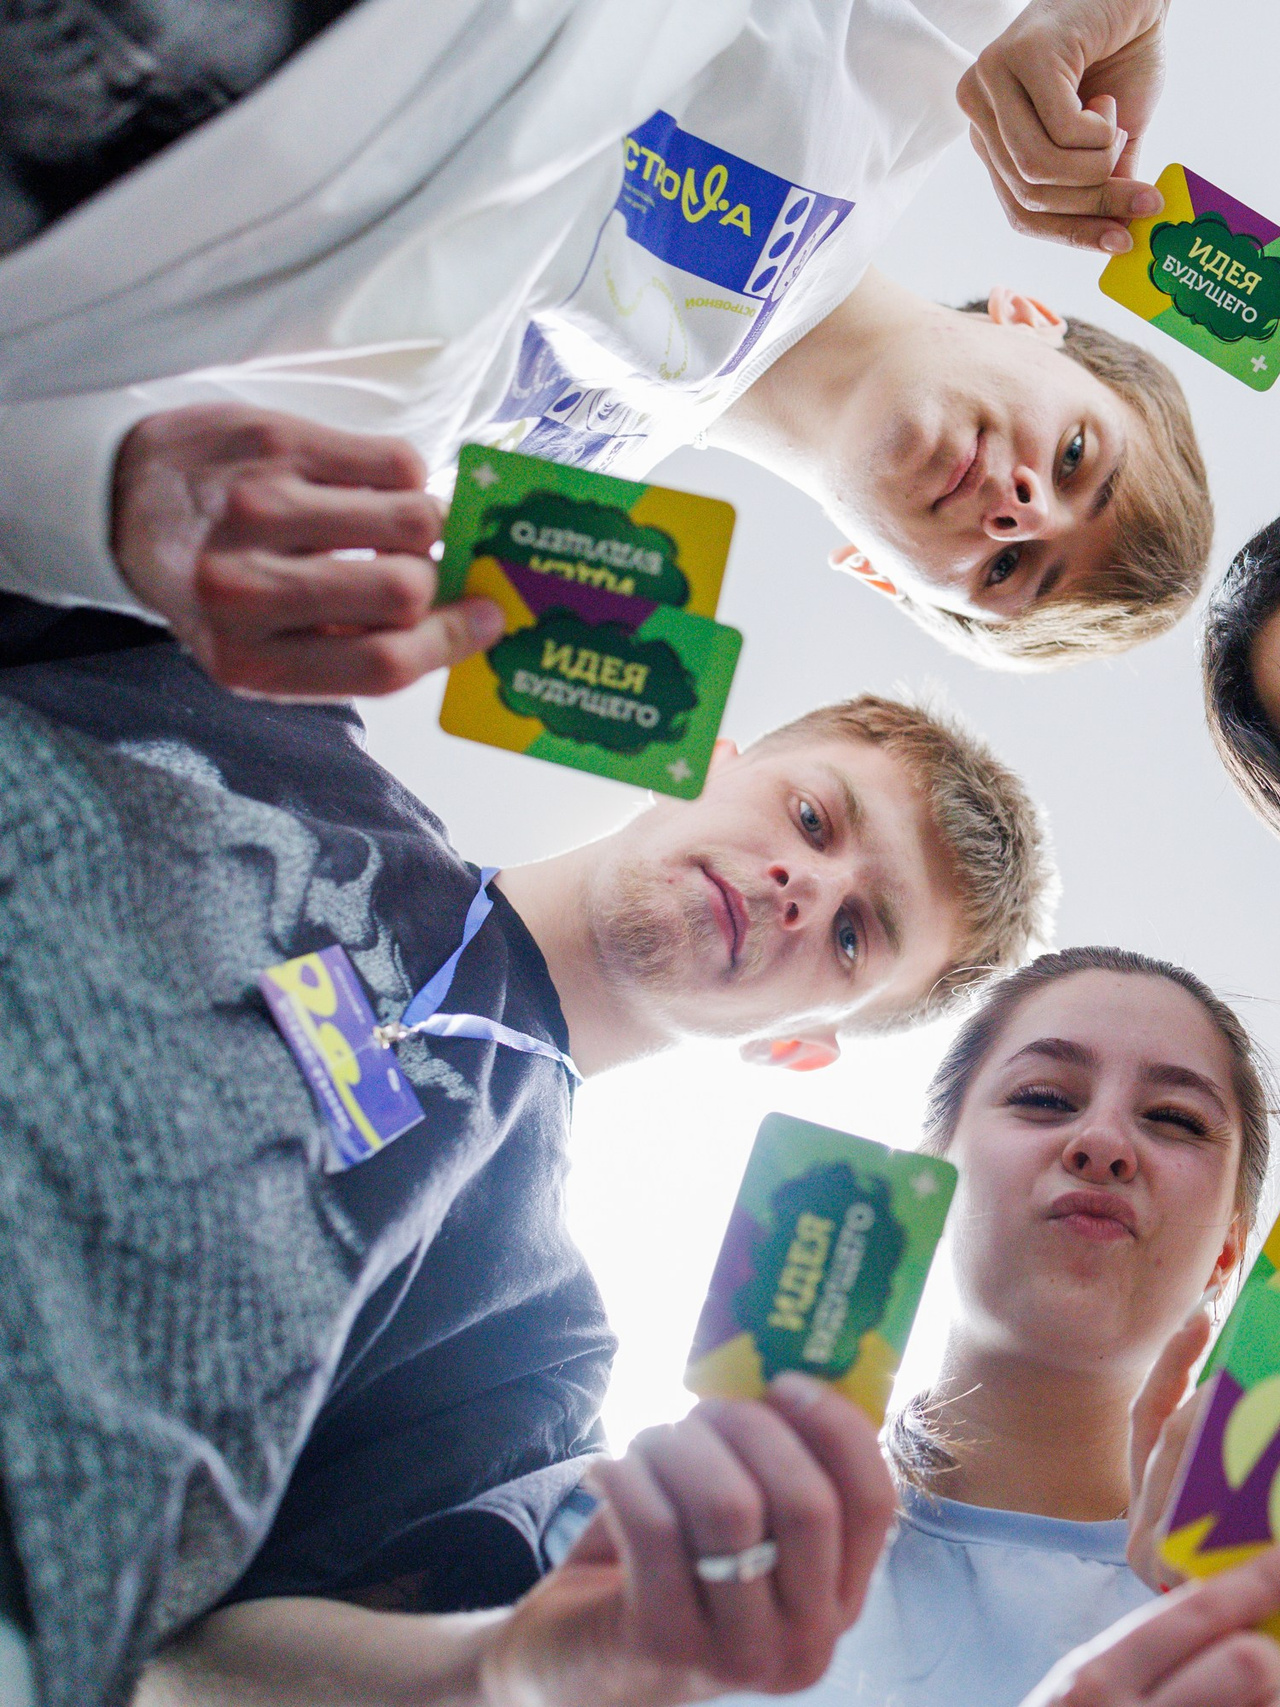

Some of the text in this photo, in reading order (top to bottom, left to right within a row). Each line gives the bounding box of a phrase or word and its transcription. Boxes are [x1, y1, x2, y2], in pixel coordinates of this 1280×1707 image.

[1162, 254, 1258, 324] БУДУЩЕГО
[1188, 236, 1263, 295] ИДЕЯ
[684, 296, 756, 319] ОСТРОВНОЙ
[510, 520, 663, 576] БУДУЩЕГО
[540, 638, 651, 694] ИДЕЯ
[512, 669, 661, 729] БУДУЩЕГО
[767, 1211, 836, 1333] ИДЕЯ
[803, 1201, 875, 1364] БУДУЩЕГО
